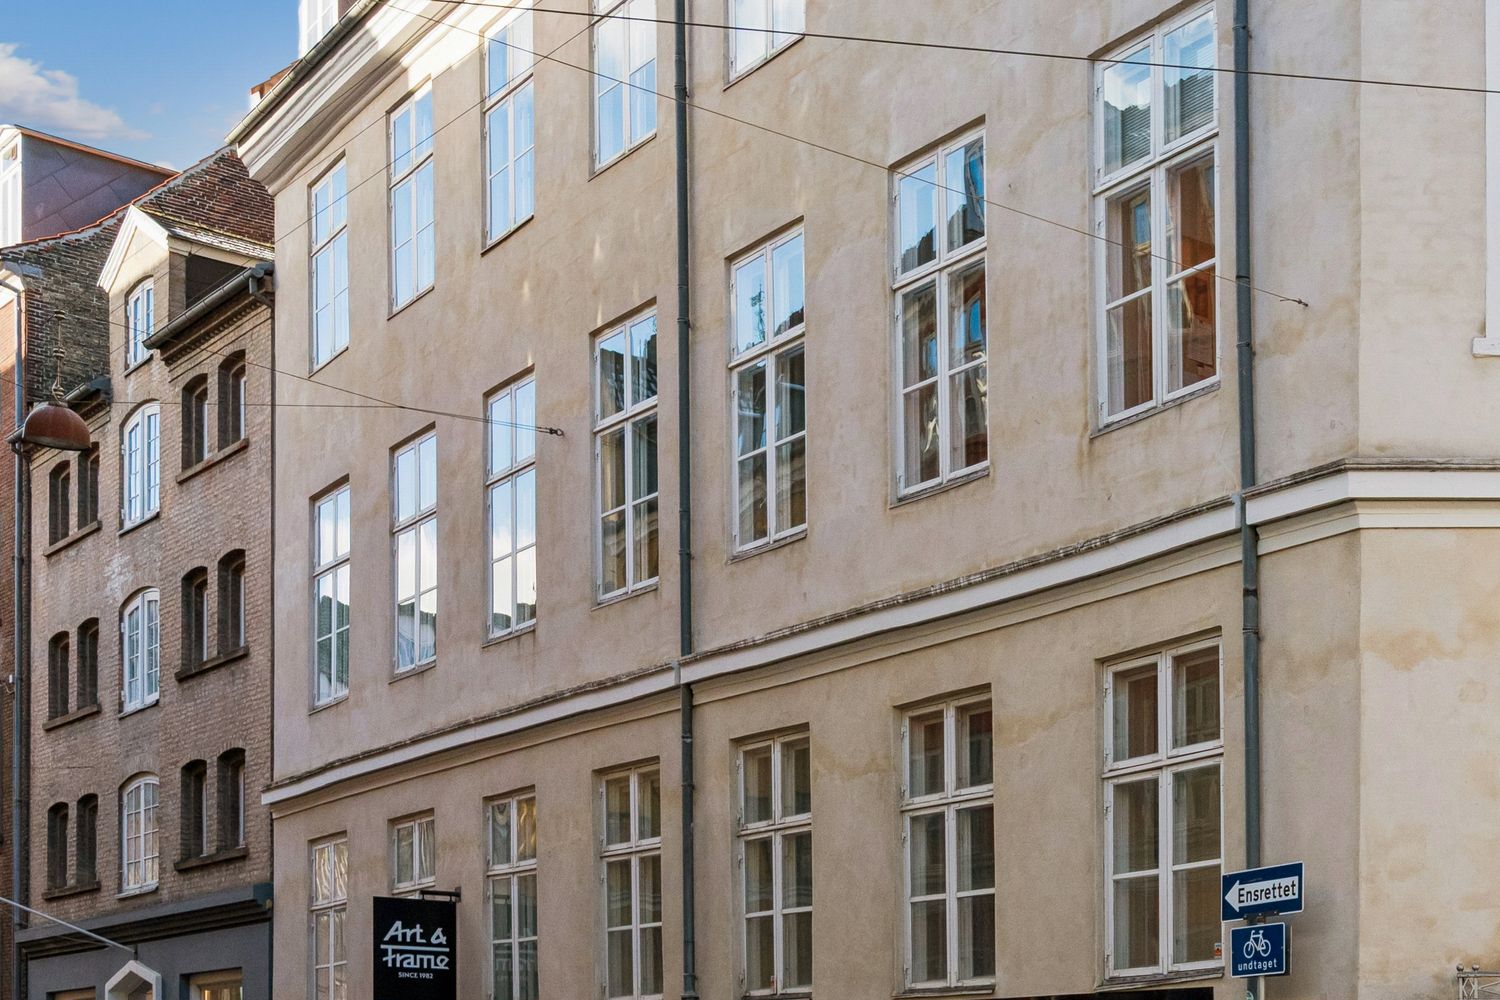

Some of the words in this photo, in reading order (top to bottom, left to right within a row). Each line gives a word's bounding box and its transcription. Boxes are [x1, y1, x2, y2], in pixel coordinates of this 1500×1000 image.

[1238, 880, 1296, 904] Ensrettet
[383, 920, 427, 943] Art
[430, 927, 447, 945] &
[1237, 958, 1278, 971] undtaget
